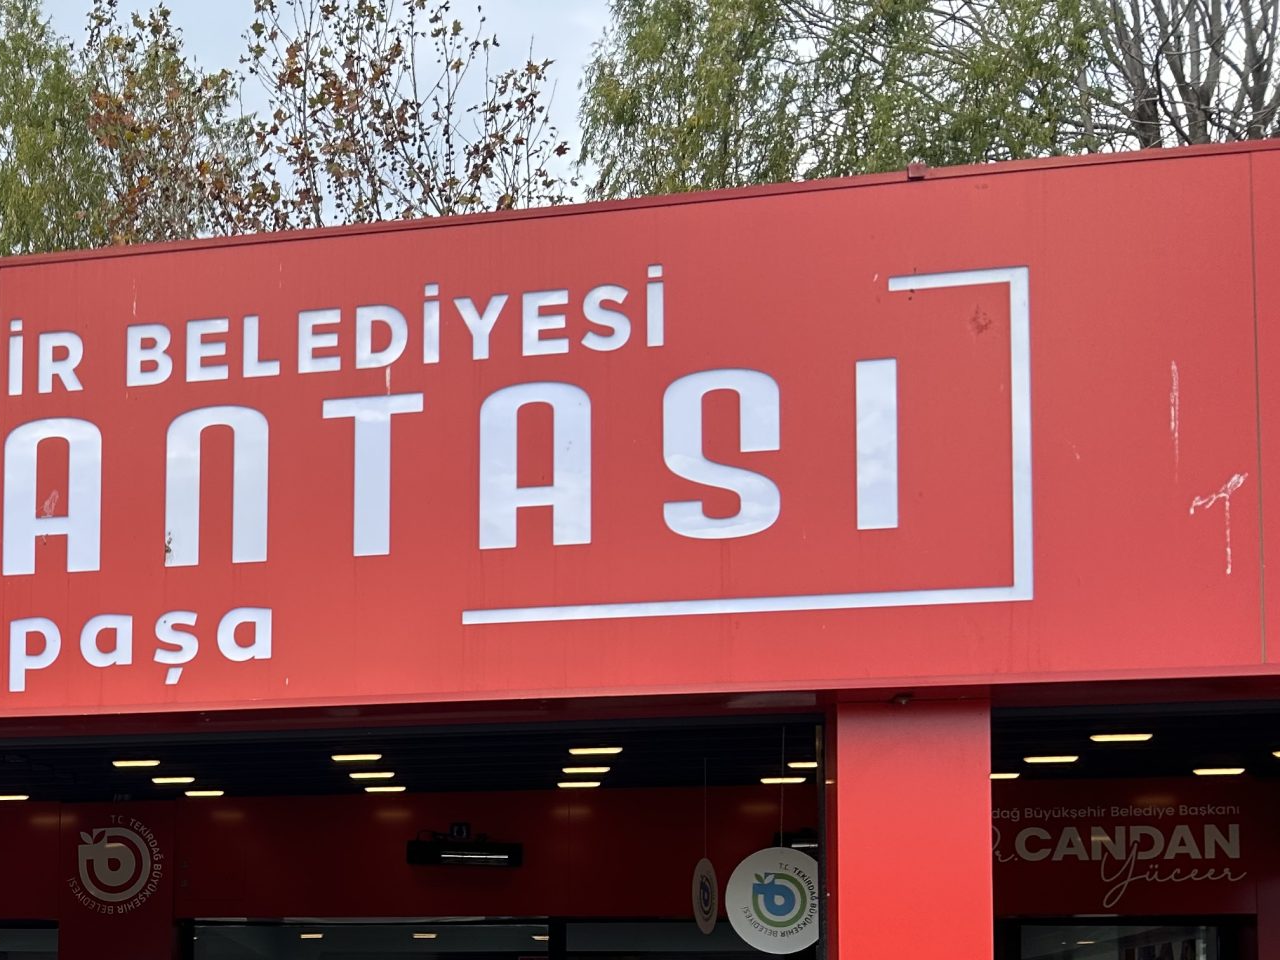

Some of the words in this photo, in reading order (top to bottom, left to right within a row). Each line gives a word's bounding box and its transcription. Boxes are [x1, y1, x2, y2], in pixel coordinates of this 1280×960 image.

[126, 263, 665, 387] BELEDİYESİ
[1024, 806, 1106, 820] Büyükşehir
[1110, 805, 1174, 820] Belediye
[1178, 804, 1240, 817] Başkanı
[129, 818, 164, 861] TEKİRDAĞ
[1014, 823, 1241, 862] CANDAN
[67, 877, 114, 914] BELEDİYESİ
[117, 863, 163, 914] BÜYÜKŞEHİR
[1100, 839, 1248, 909] Yüceer
